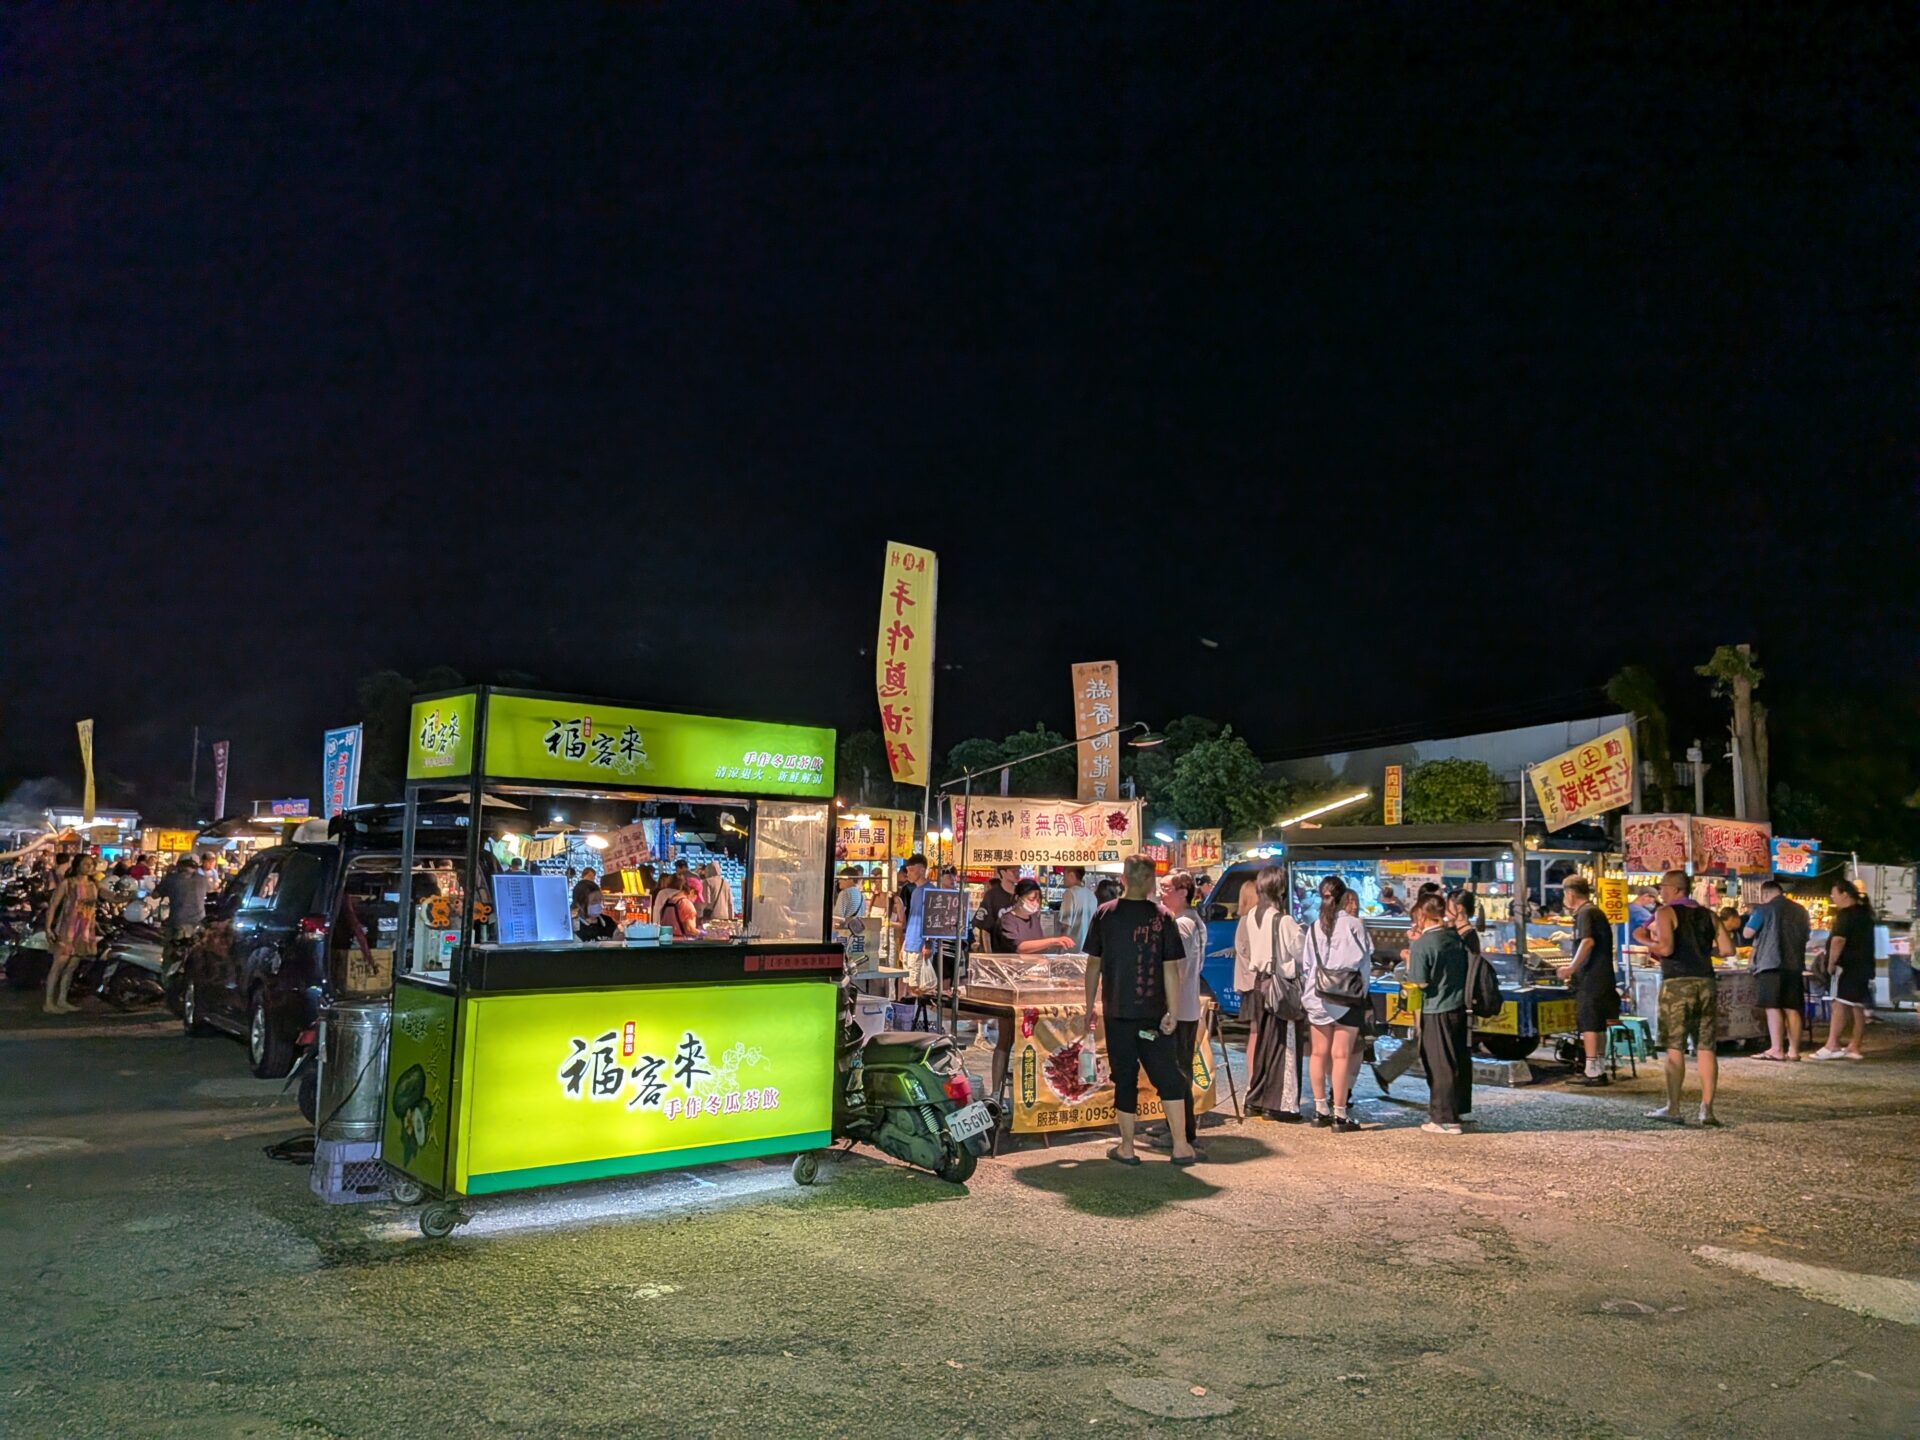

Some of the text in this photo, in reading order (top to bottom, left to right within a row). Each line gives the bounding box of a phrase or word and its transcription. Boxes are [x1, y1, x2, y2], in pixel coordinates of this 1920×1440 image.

[544, 718, 646, 767] 福客來
[1020, 849, 1096, 862] 0953-468880
[1786, 854, 1803, 864] 39
[561, 1031, 711, 1106] 福客來
[663, 1088, 780, 1120] 手作冬瓜茶飲
